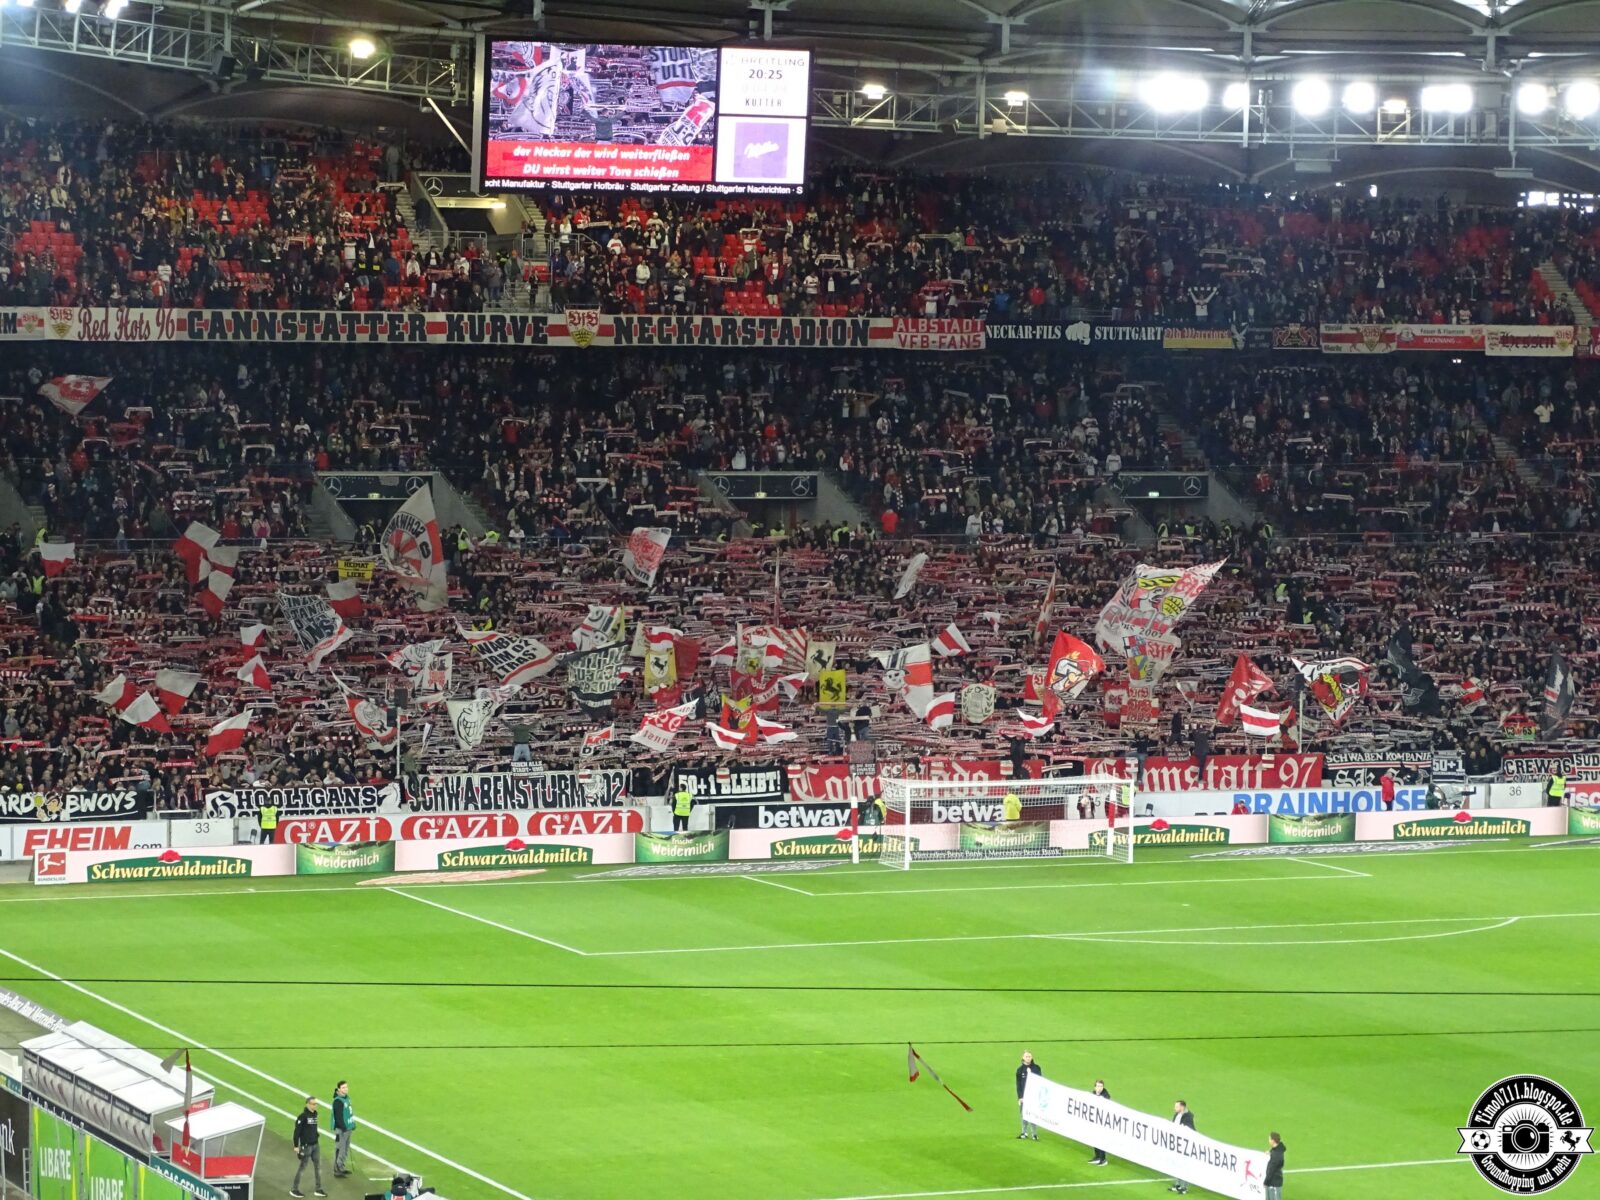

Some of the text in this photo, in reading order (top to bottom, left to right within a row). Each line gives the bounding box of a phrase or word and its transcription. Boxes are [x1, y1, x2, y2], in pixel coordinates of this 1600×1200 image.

[741, 57, 805, 67] BREITLING
[749, 69, 783, 79] 20:25
[513, 146, 690, 162] der Neckar der wird weiterfließen
[523, 164, 679, 180] DU wirst weiter Tore schießen
[502, 180, 545, 188] Manufaktur
[551, 181, 592, 191] Stuttgarter
[594, 181, 624, 190] Hofbräu
[630, 182, 670, 192] Stuttgarter
[672, 183, 700, 194] Zeitung
[706, 184, 746, 194] Stuttgarter
[747, 185, 790, 194] Nachrichten
[78, 307, 175, 341] Red Hots 96
[187, 311, 871, 347] CANNSTATTER KURVE NECKARSTADION
[896, 318, 983, 333] ALBSTADT
[986, 324, 1163, 341] NECKAR-FILS STUTTGART
[898, 333, 982, 349] VFB-FANS
[1326, 751, 1384, 763] SCHWABEN
[1432, 758, 1466, 772] 50+1
[1278, 756, 1318, 789] 97
[1505, 758, 1551, 775] CREW
[678, 774, 717, 795] 50+1
[1509, 786, 1522, 796] 36
[65, 790, 138, 814] BWOYS
[236, 786, 377, 809] HOOLIGANS
[758, 806, 851, 829] betway
[932, 801, 1005, 824] betwa
[195, 822, 210, 834] 33
[1283, 822, 1342, 837] Weidemilch
[1397, 820, 1526, 838] Schwarzwaldmilch
[441, 846, 588, 867] Schwarzwaldmilch
[651, 840, 714, 857] Weidemilch
[313, 852, 380, 869] Weidemilch
[91, 859, 246, 880] Schwarzwaldmilch
[1067, 1097, 1129, 1136] EHRENAMT
[1131, 1120, 1149, 1142] IST
[1151, 1128, 1238, 1173] UNBEZAHLBAR
[40, 1146, 72, 1181] LIBARE
